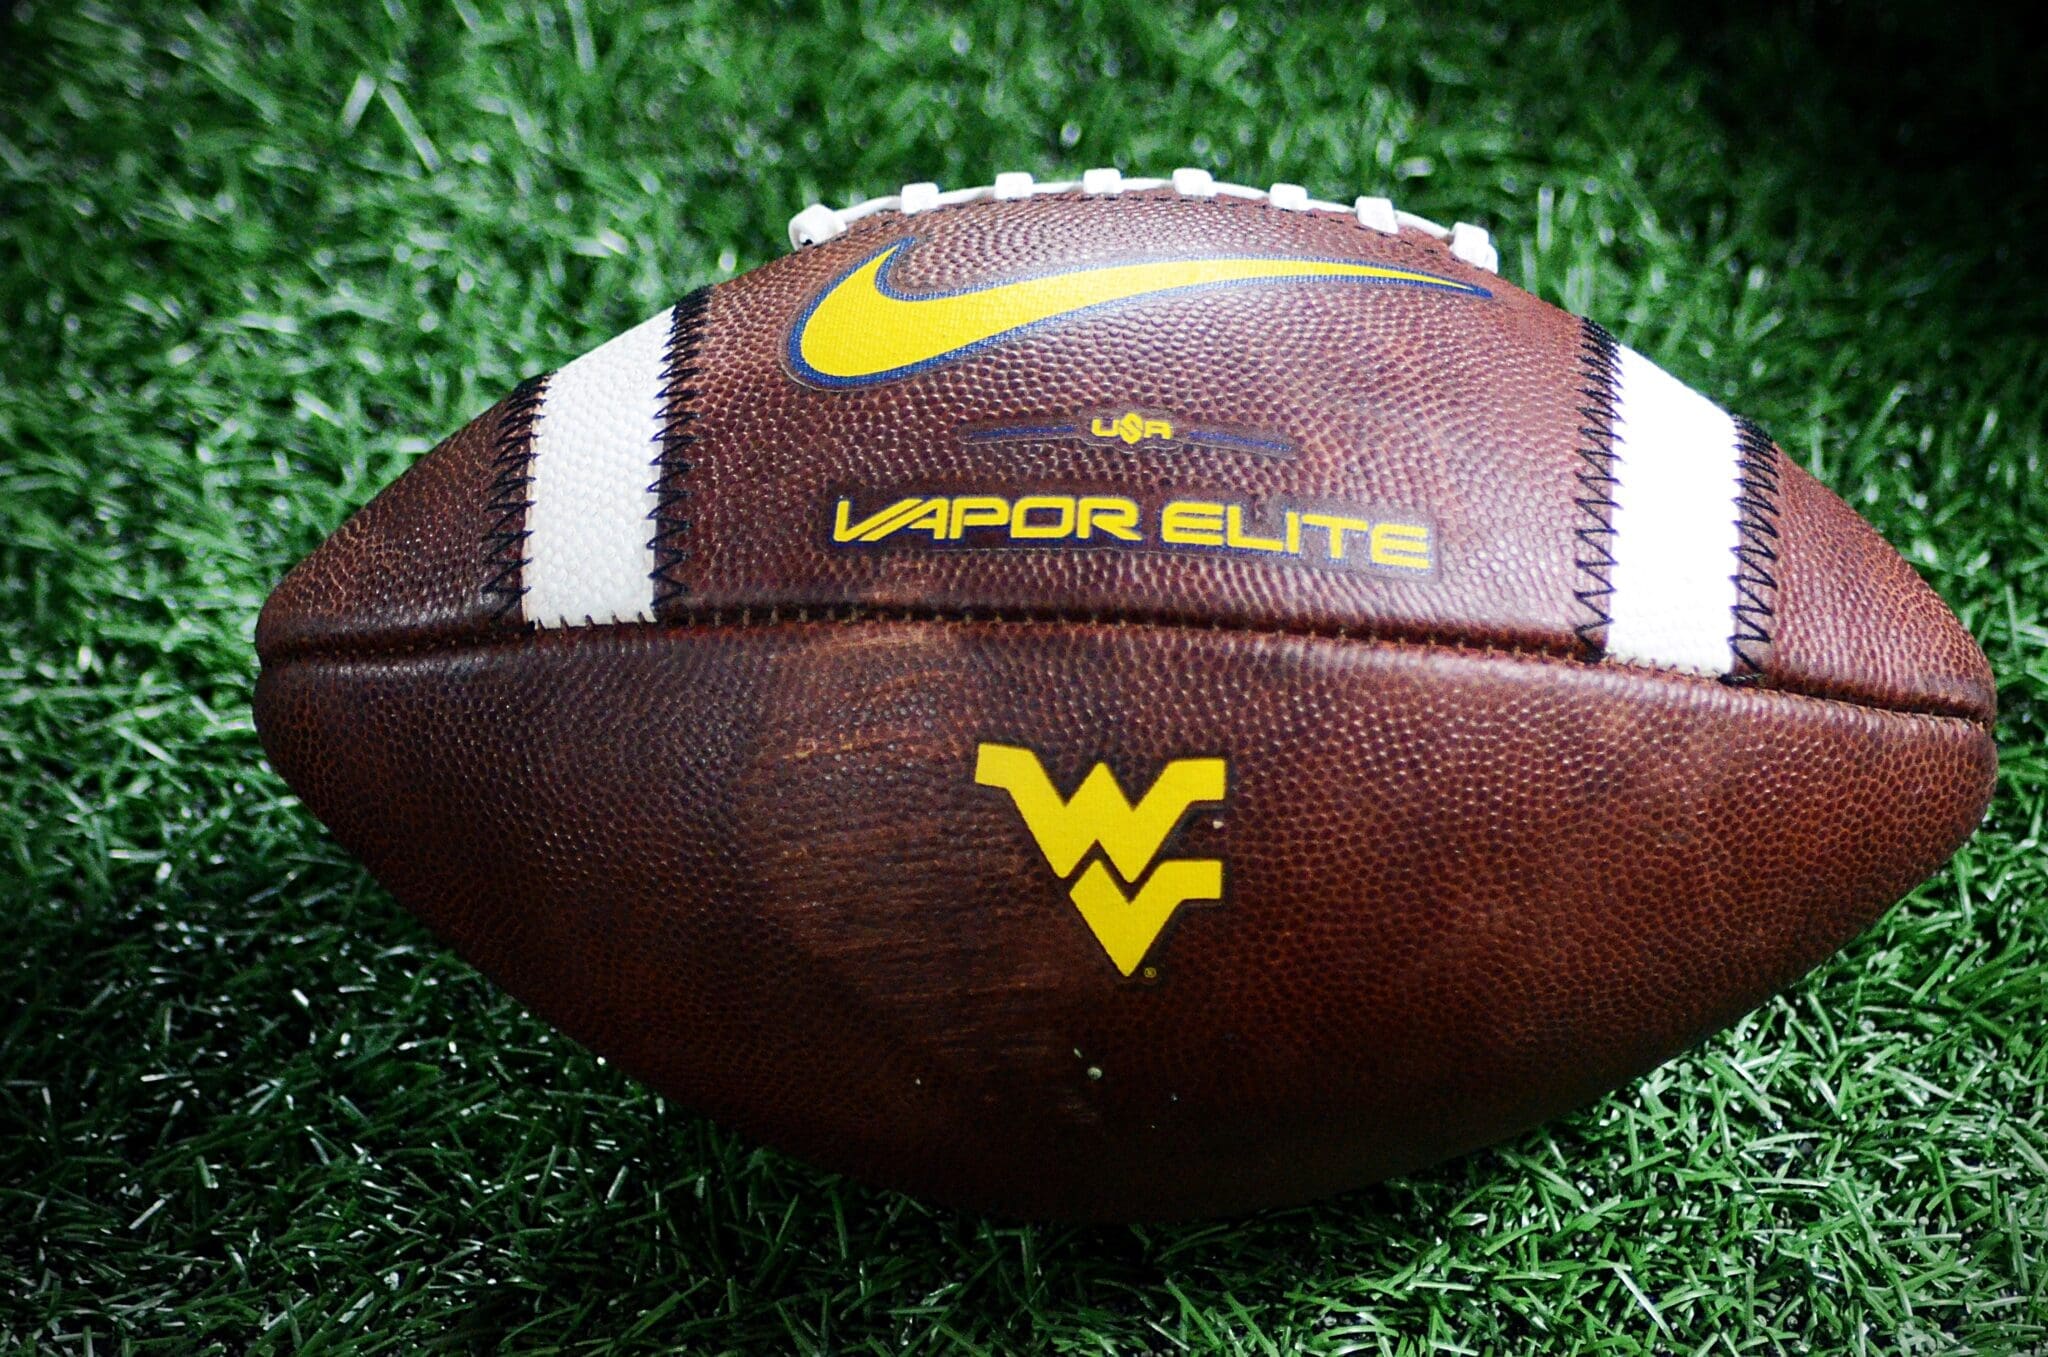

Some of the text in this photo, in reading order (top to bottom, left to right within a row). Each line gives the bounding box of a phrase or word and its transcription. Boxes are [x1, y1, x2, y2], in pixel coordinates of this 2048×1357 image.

[1092, 411, 1174, 445] USA
[833, 496, 1434, 570] VAPOR ELITE
